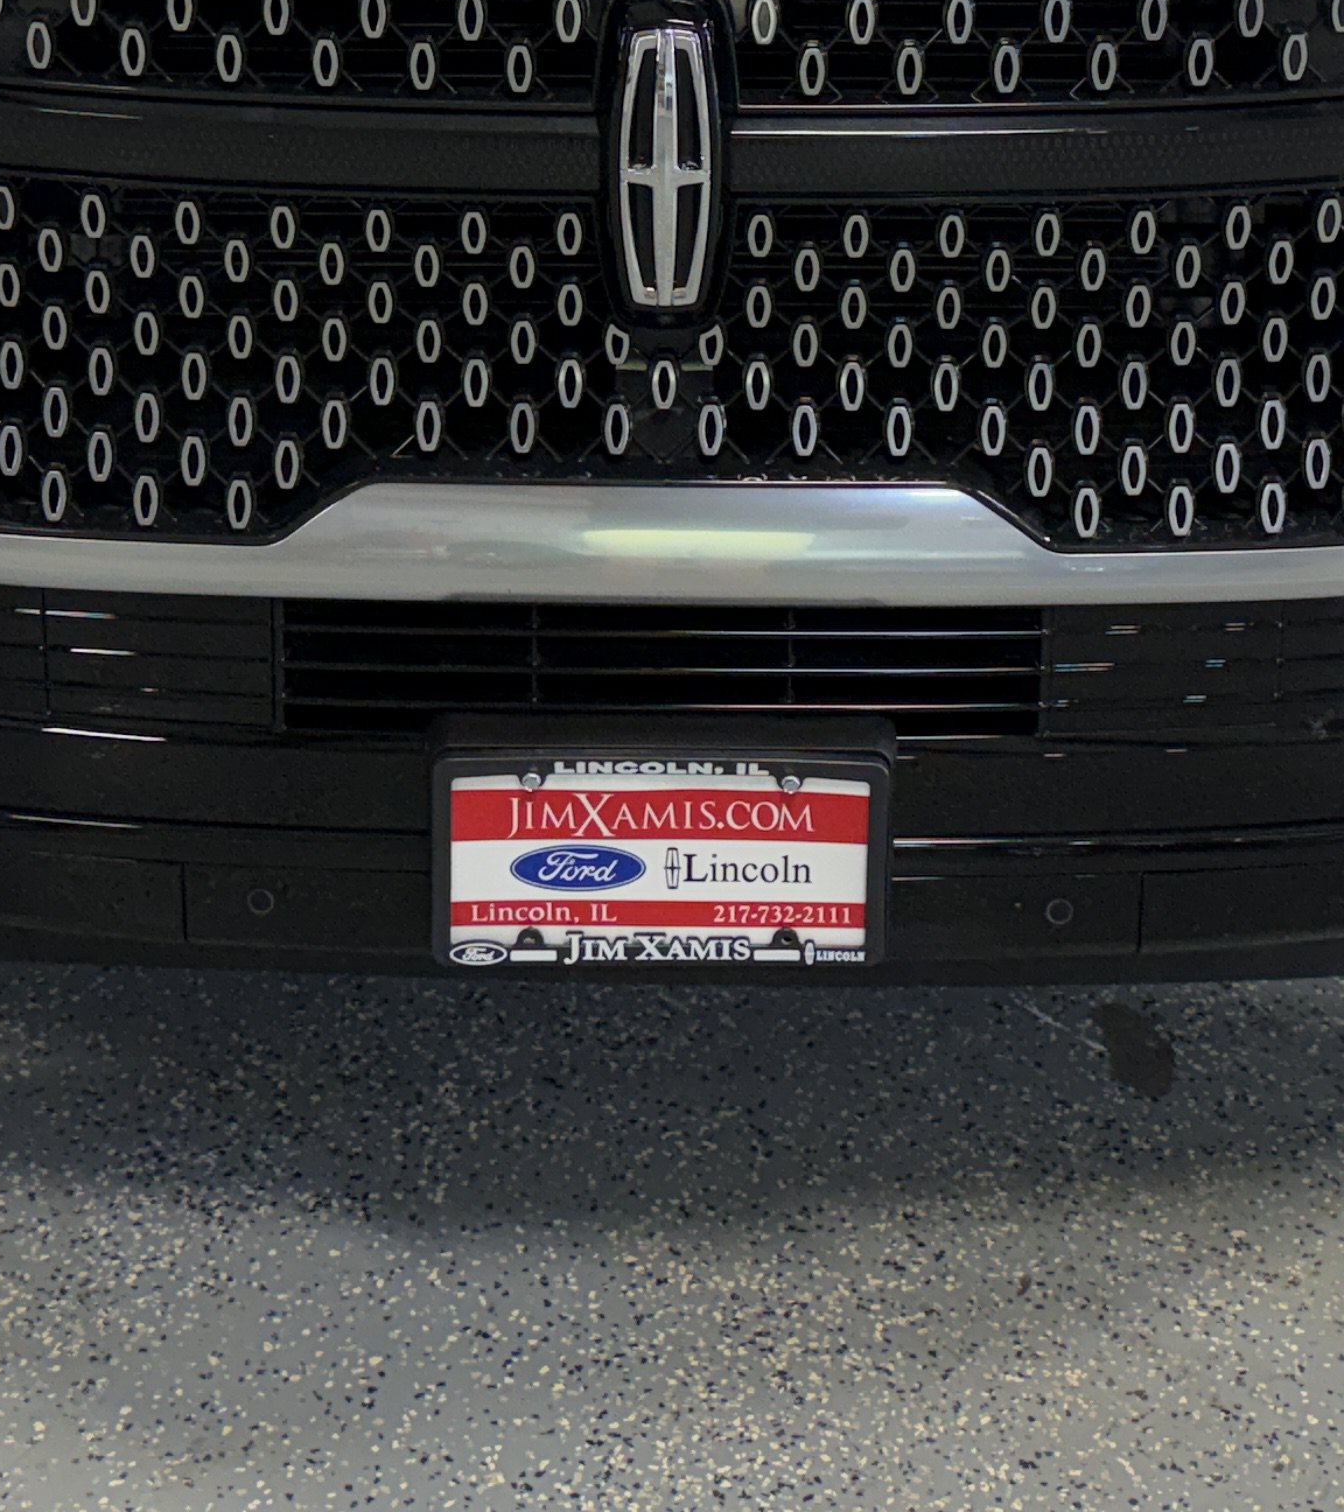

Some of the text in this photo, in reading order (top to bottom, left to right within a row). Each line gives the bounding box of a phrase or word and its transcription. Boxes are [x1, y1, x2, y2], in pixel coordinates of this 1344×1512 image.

[554, 761, 770, 776] LINCOLN, IL
[507, 793, 815, 838] JIMXAMIS.COM
[538, 851, 619, 882] Ford
[683, 853, 813, 884] Lincoln
[471, 902, 617, 924] Lincoln, IL
[713, 905, 851, 924] 217-732-2111
[563, 933, 751, 965] JIM XAMIS
[815, 951, 866, 962] LINCOLN
